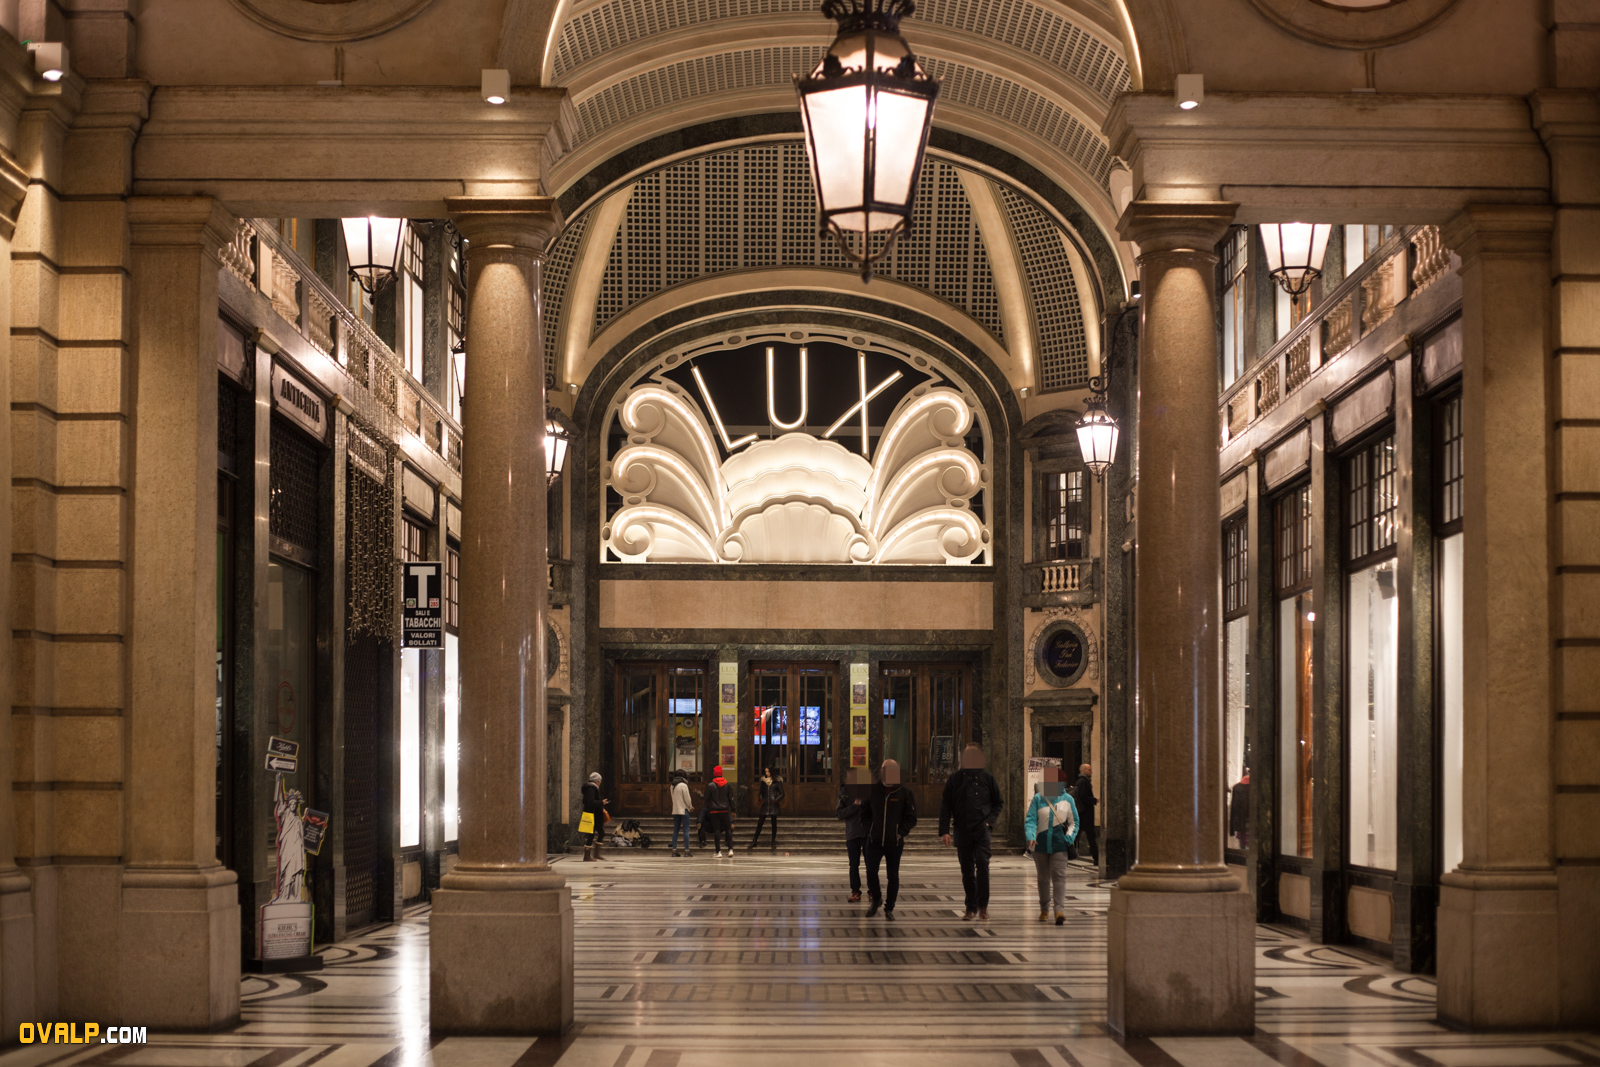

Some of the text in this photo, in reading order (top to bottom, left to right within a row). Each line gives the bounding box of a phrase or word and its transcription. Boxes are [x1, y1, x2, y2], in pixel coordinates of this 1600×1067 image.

[690, 347, 903, 458] LUX
[409, 566, 436, 608] T
[405, 617, 441, 628] TABACCHI
